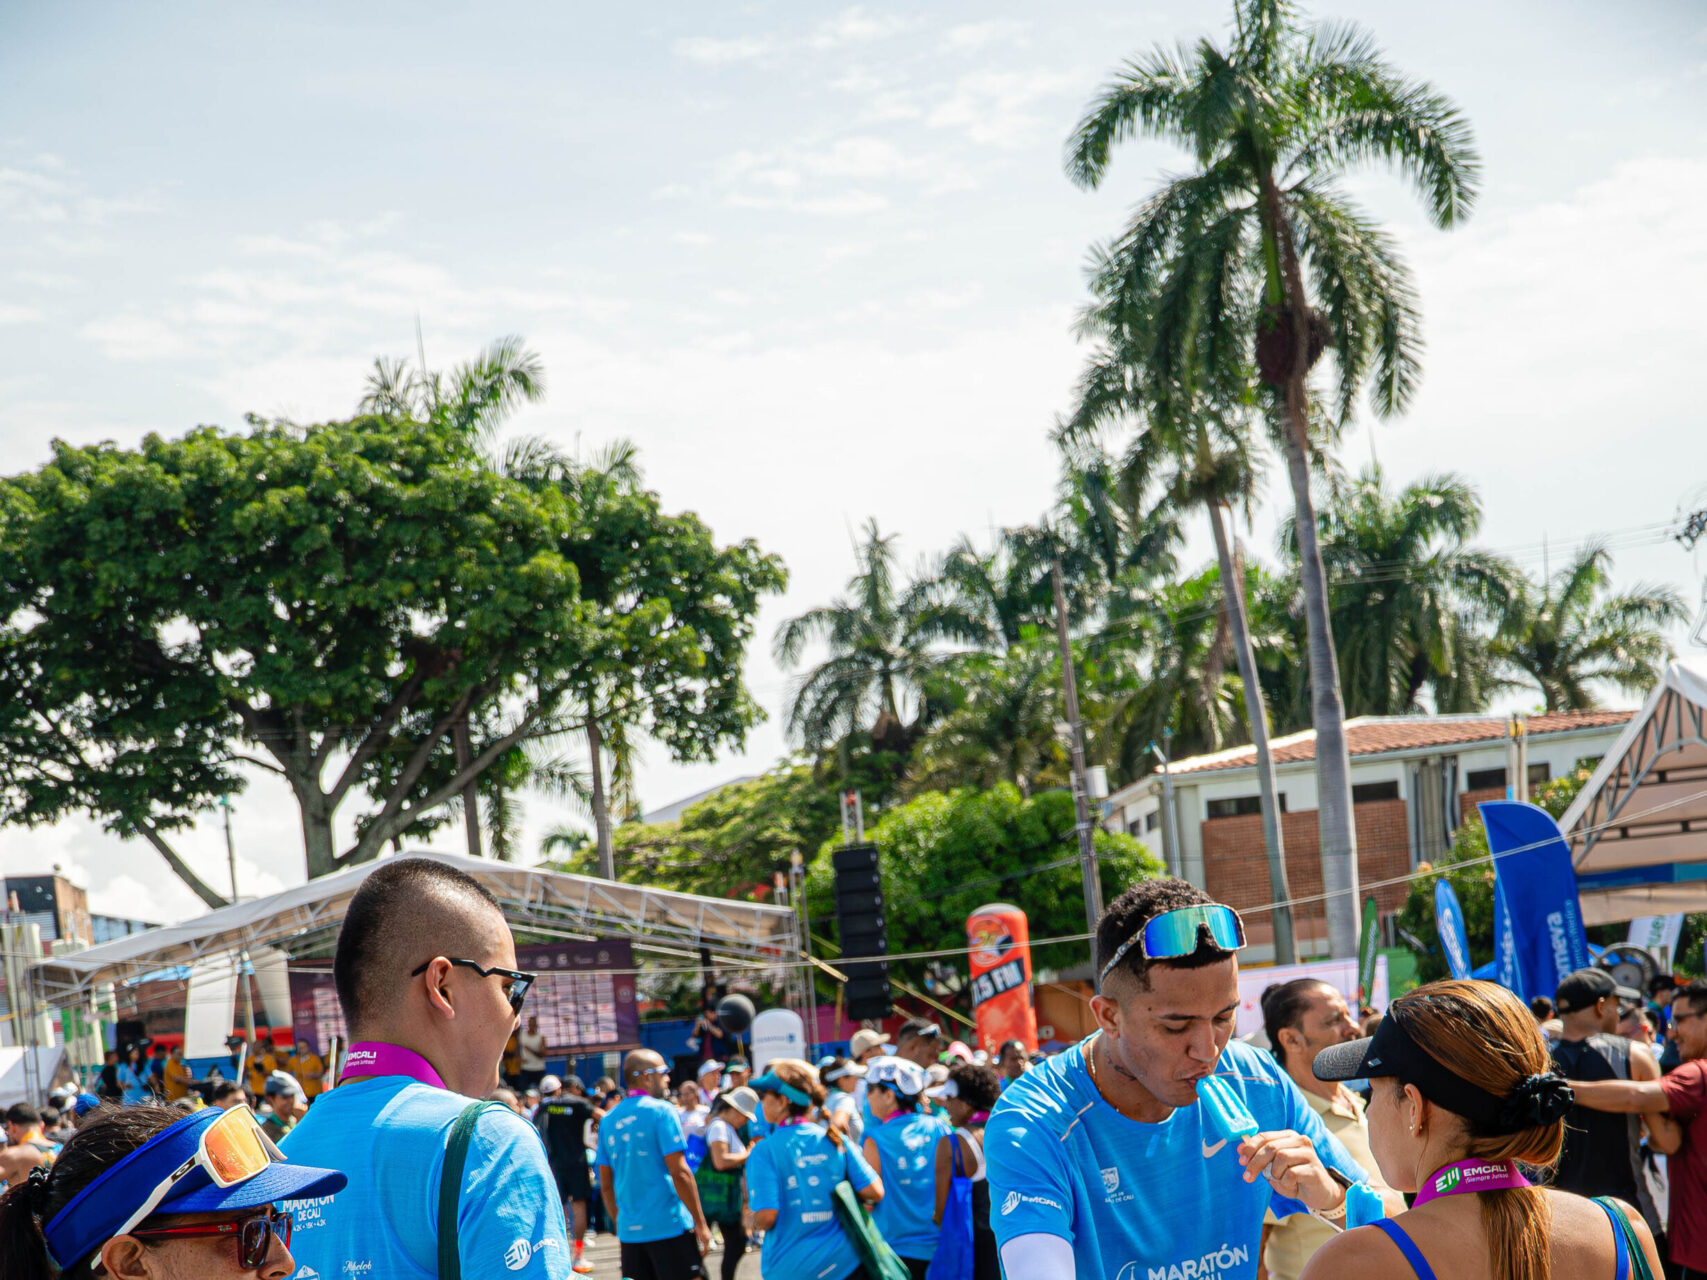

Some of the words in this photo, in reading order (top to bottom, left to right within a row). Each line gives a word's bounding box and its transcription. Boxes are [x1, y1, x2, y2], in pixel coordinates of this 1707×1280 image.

[1546, 911, 1573, 982] omeva
[1463, 1164, 1507, 1177] EMCALI
[307, 1207, 321, 1220] CALI
